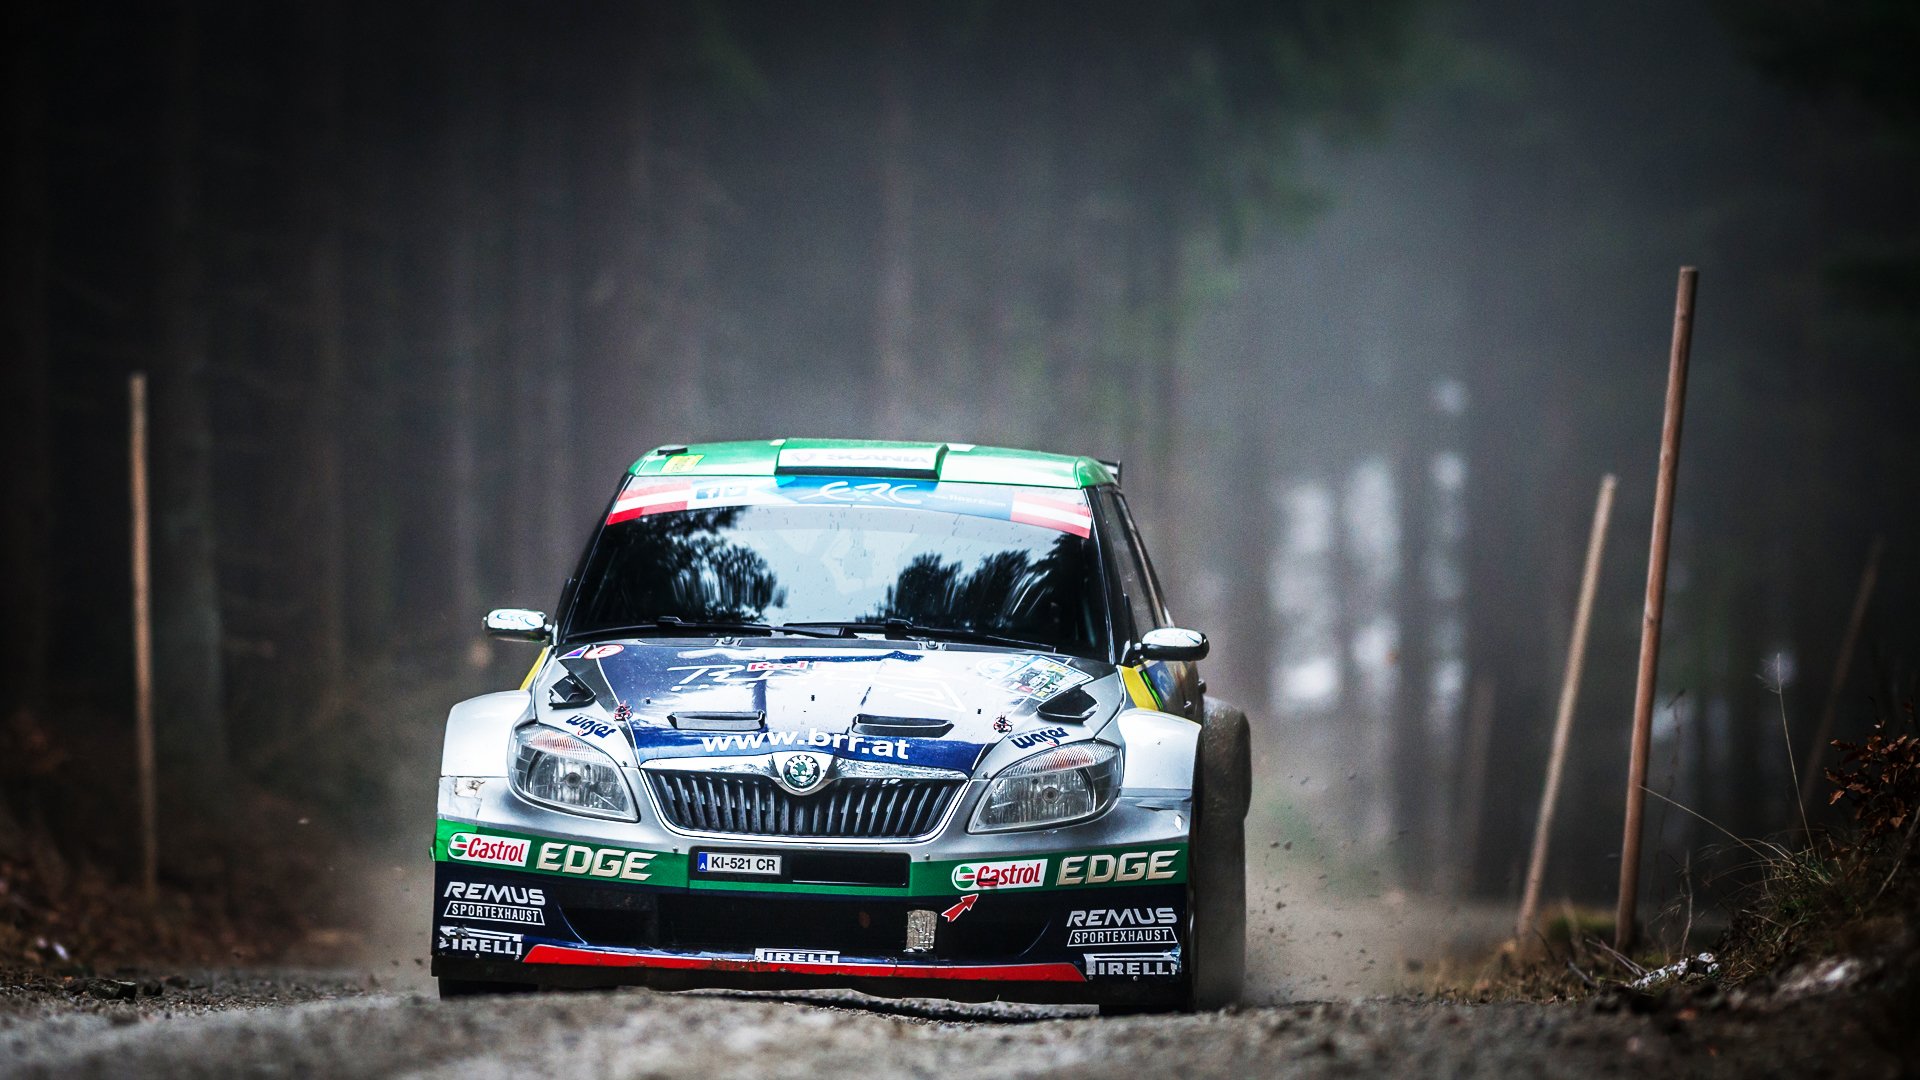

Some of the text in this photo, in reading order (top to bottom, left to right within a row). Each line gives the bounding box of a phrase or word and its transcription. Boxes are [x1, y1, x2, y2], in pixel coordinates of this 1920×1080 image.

[700, 727, 910, 760] www.brr.at
[467, 837, 658, 881] Castrol EDGE
[711, 856, 776, 871] KI-521 CR
[1056, 849, 1181, 886] EDGE
[443, 881, 546, 906] REMUS
[451, 903, 540, 922] SPORTEXHAUST
[1066, 907, 1178, 928] REMUS
[1074, 929, 1170, 944] SPORTEXHAUST
[755, 948, 841, 964] PIRELLI
